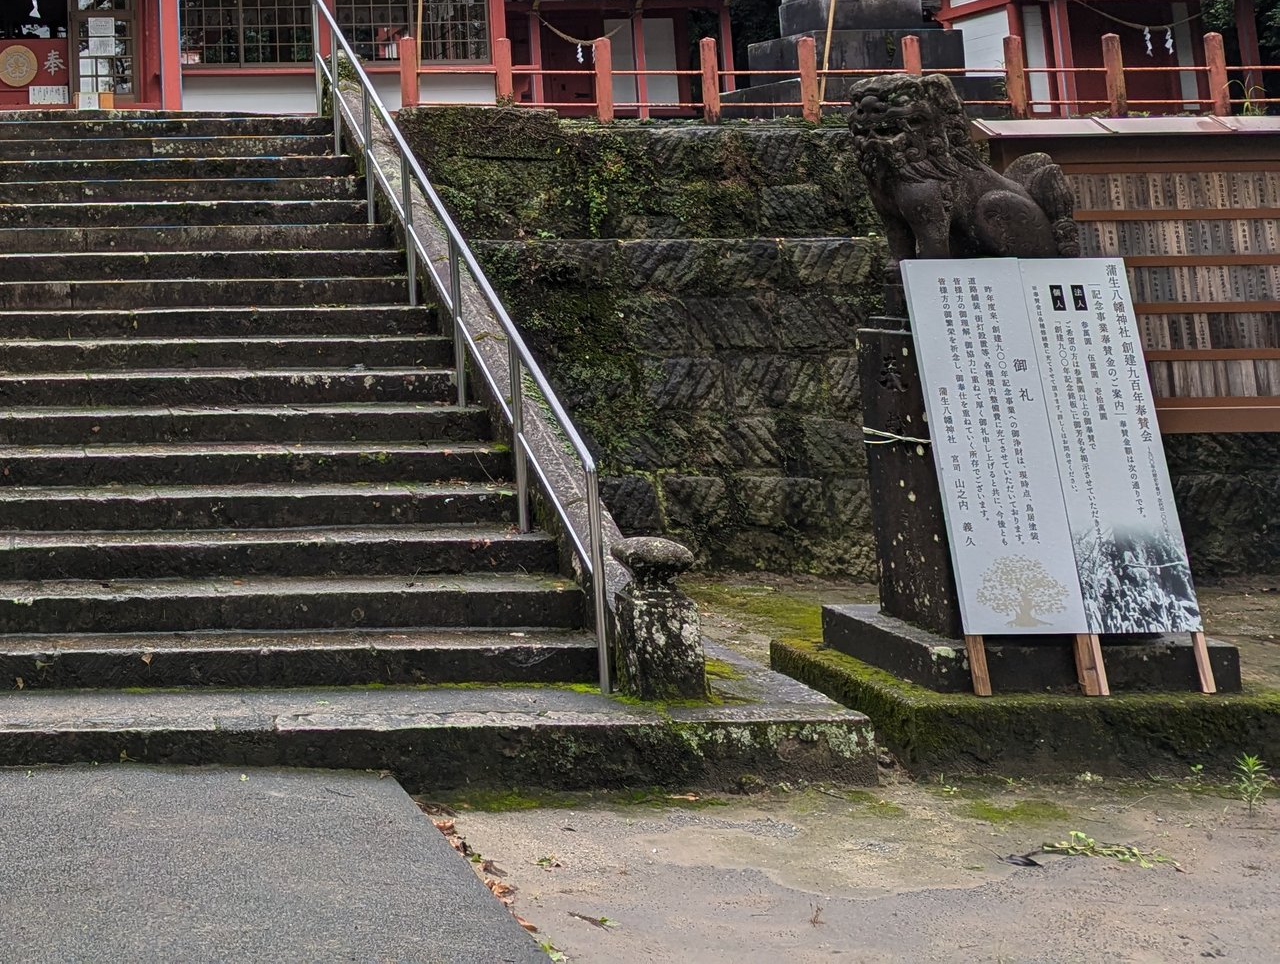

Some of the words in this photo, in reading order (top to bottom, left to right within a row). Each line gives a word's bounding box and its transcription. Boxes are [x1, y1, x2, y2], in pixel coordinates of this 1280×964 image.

[44, 49, 66, 76] 奉
[1052, 288, 1064, 308] 個人
[1073, 288, 1085, 308] 法人
[1091, 289, 1125, 411] 記念事業奉賛金のご案内
[1105, 264, 1131, 338] 蒲生八幡神社
[1122, 342, 1152, 442] 創建九百年奉賛会
[938, 387, 957, 444] 蒲生八幡神社
[951, 455, 961, 471] 宮司
[954, 478, 969, 511] 山之内
[962, 522, 976, 547] 義久
